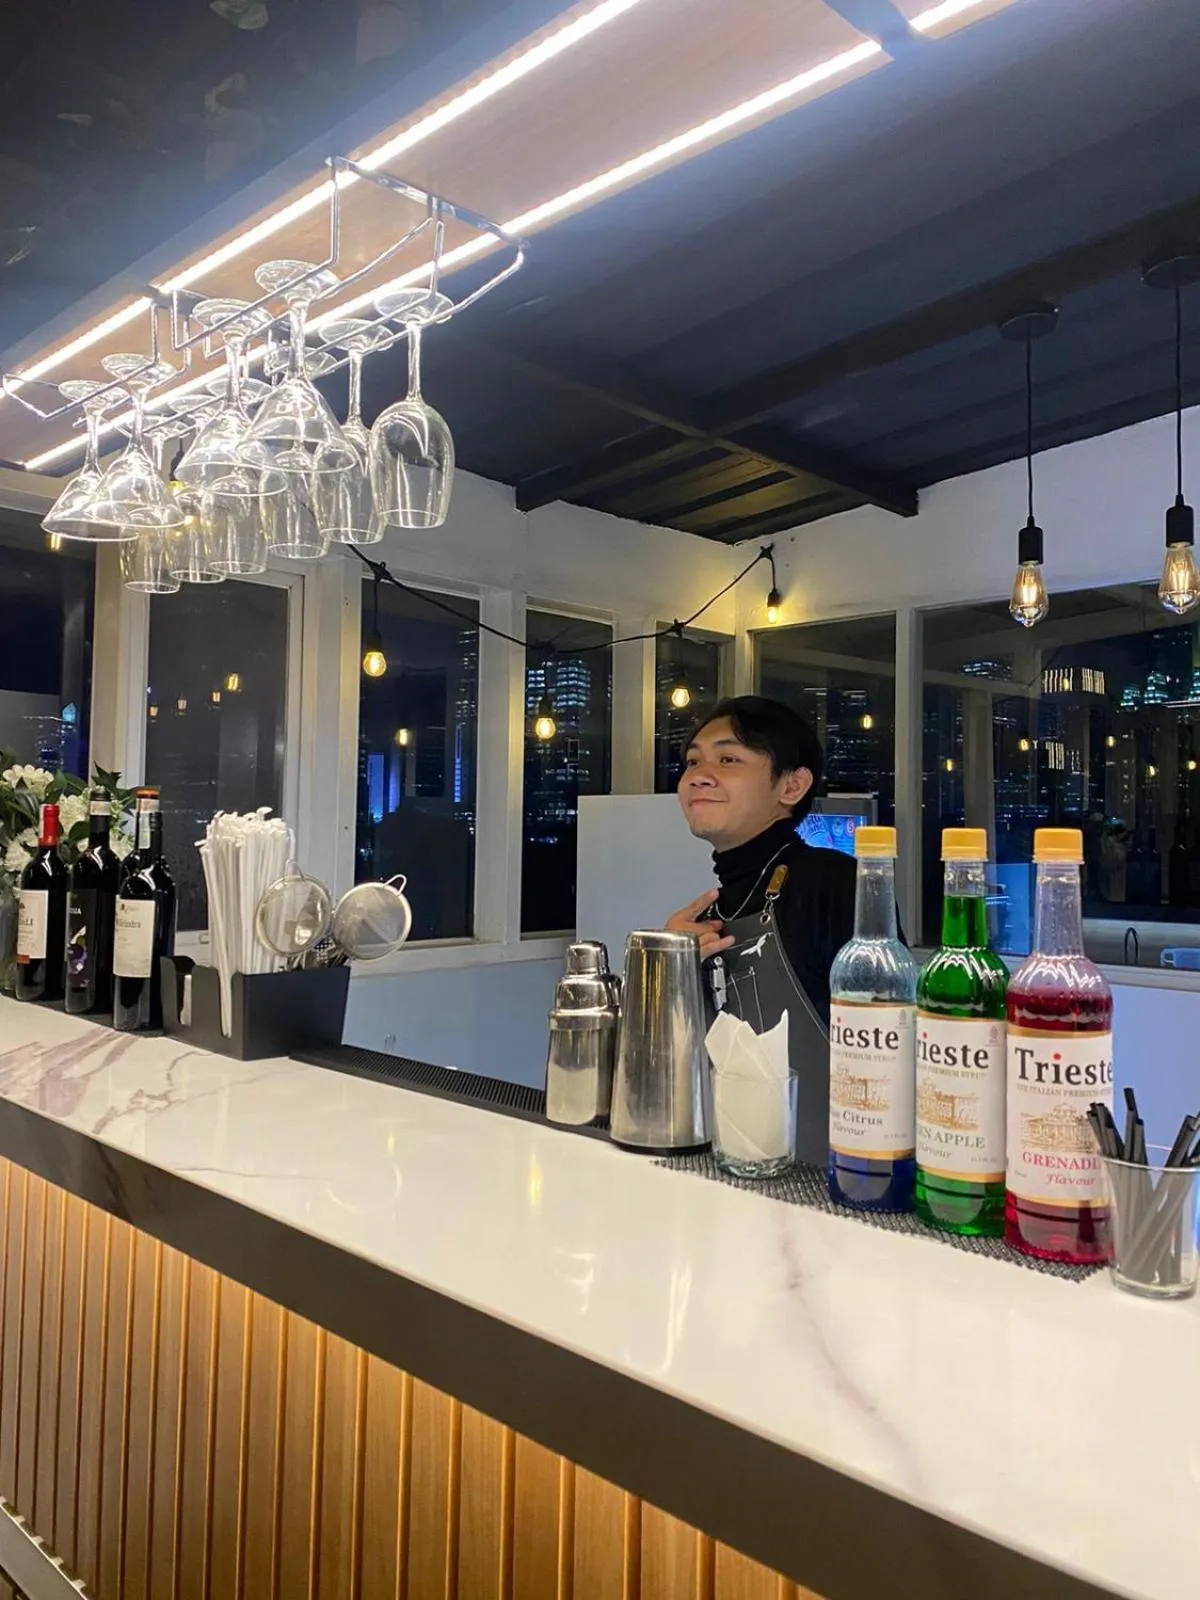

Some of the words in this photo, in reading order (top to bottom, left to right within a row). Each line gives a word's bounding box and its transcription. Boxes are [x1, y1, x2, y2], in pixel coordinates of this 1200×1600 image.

[830, 1016, 899, 1050] rieste
[916, 1031, 989, 1069] rieste
[1014, 1047, 1113, 1086] Trieste
[842, 1110, 883, 1126] Citrus
[931, 1129, 985, 1149] APPLE
[1022, 1151, 1100, 1171] GRENADI
